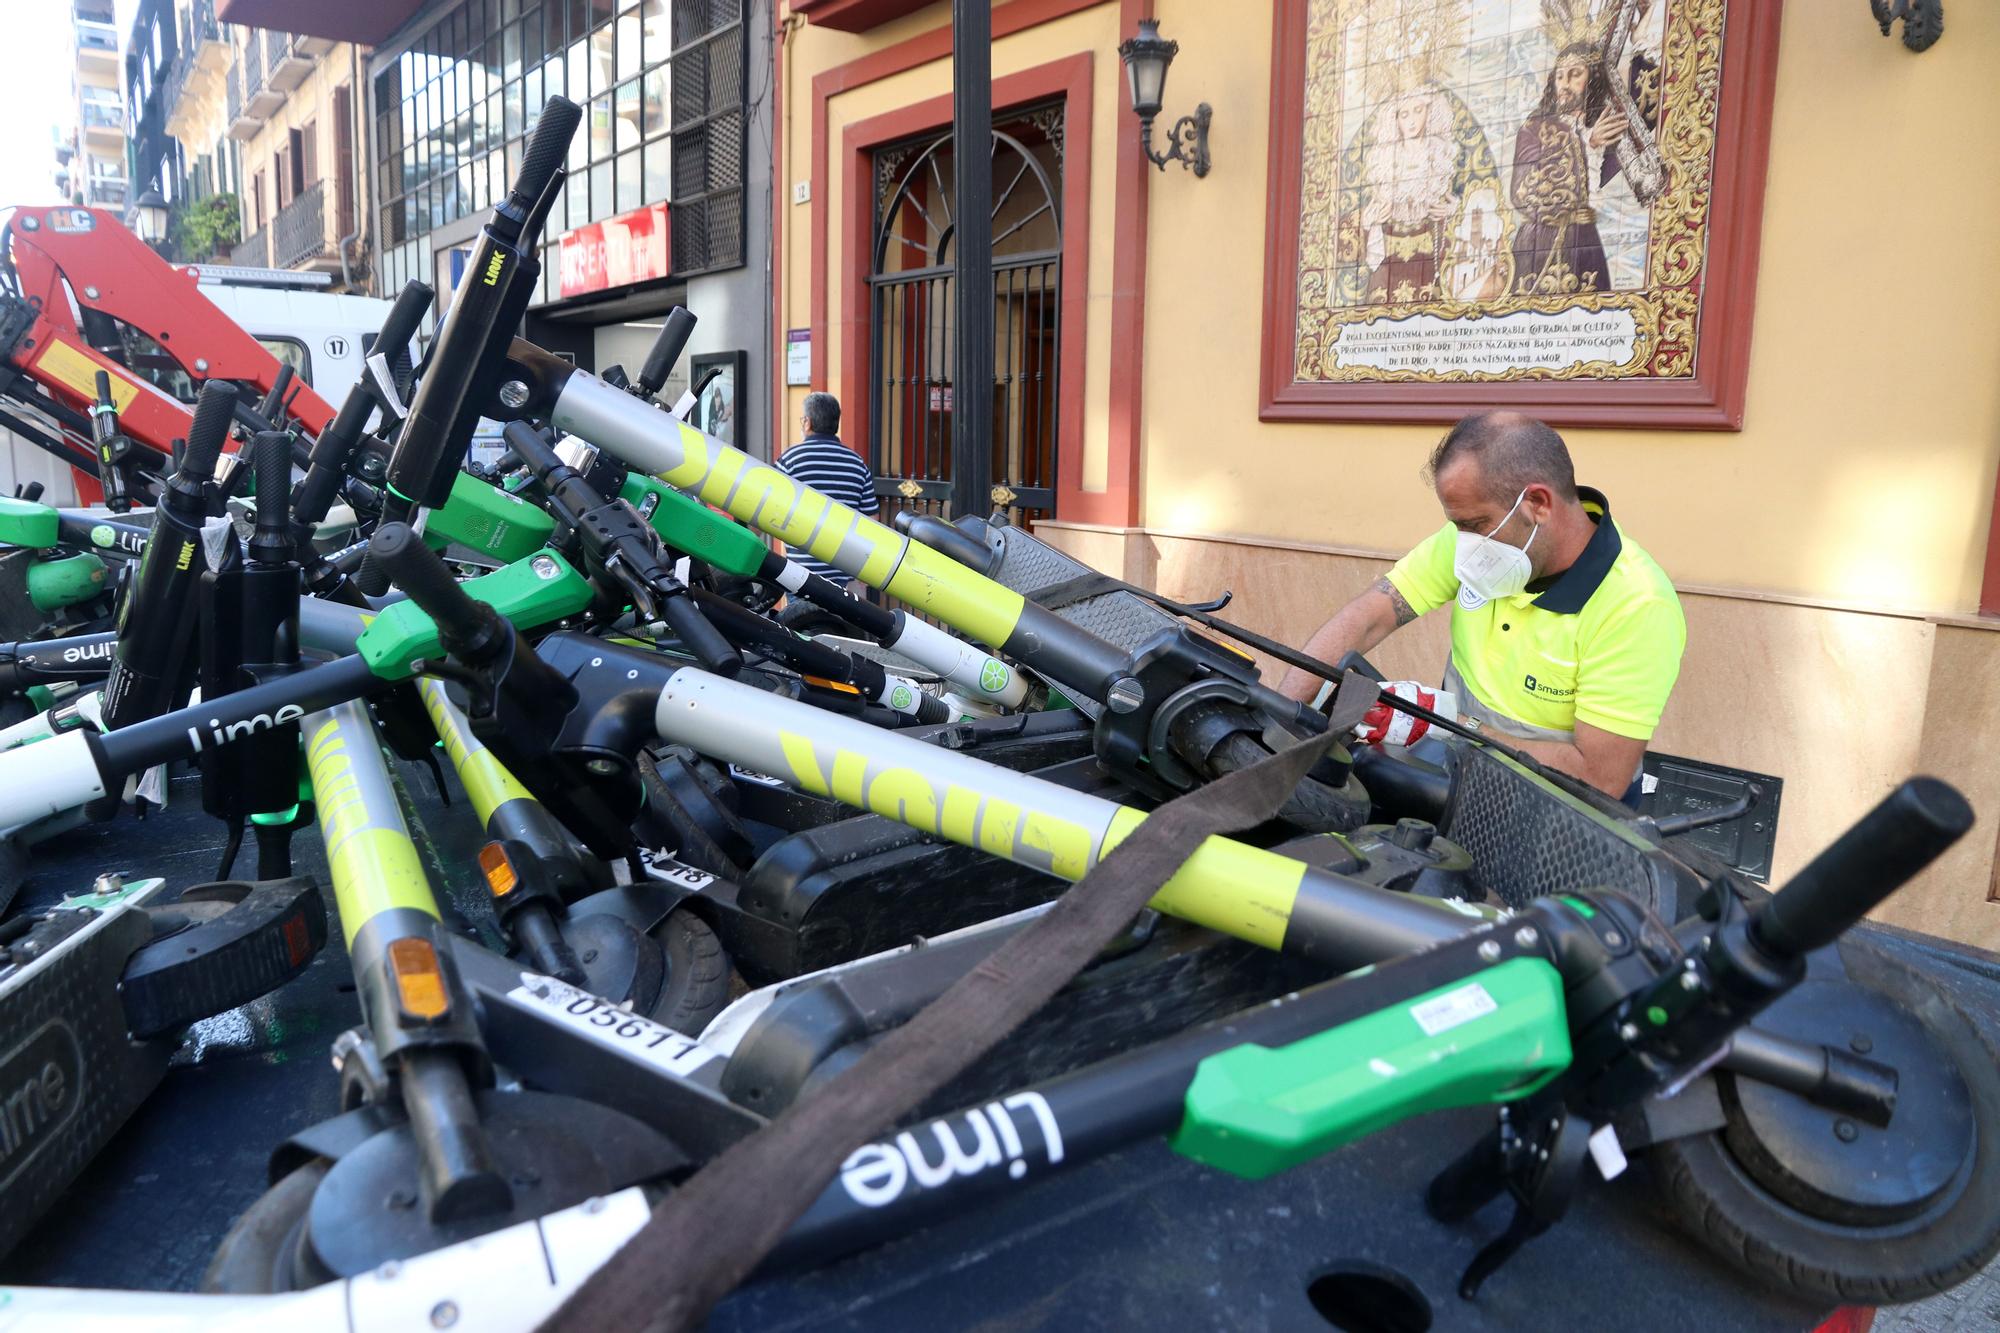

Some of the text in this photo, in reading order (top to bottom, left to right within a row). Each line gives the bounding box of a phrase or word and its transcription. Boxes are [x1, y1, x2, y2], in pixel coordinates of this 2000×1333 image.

[483, 250, 506, 286] LINK
[1482, 326, 1525, 335] VENERABLE
[330, 340, 343, 355] 17
[1391, 344, 1425, 353] NUESTRO
[1428, 343, 1451, 352] PADRE
[1534, 339, 1553, 350] BAJO
[1389, 357, 1398, 365] DE
[1535, 353, 1561, 363] AMOR
[177, 540, 196, 571] LINK
[841, 1091, 1064, 1208] Lime
